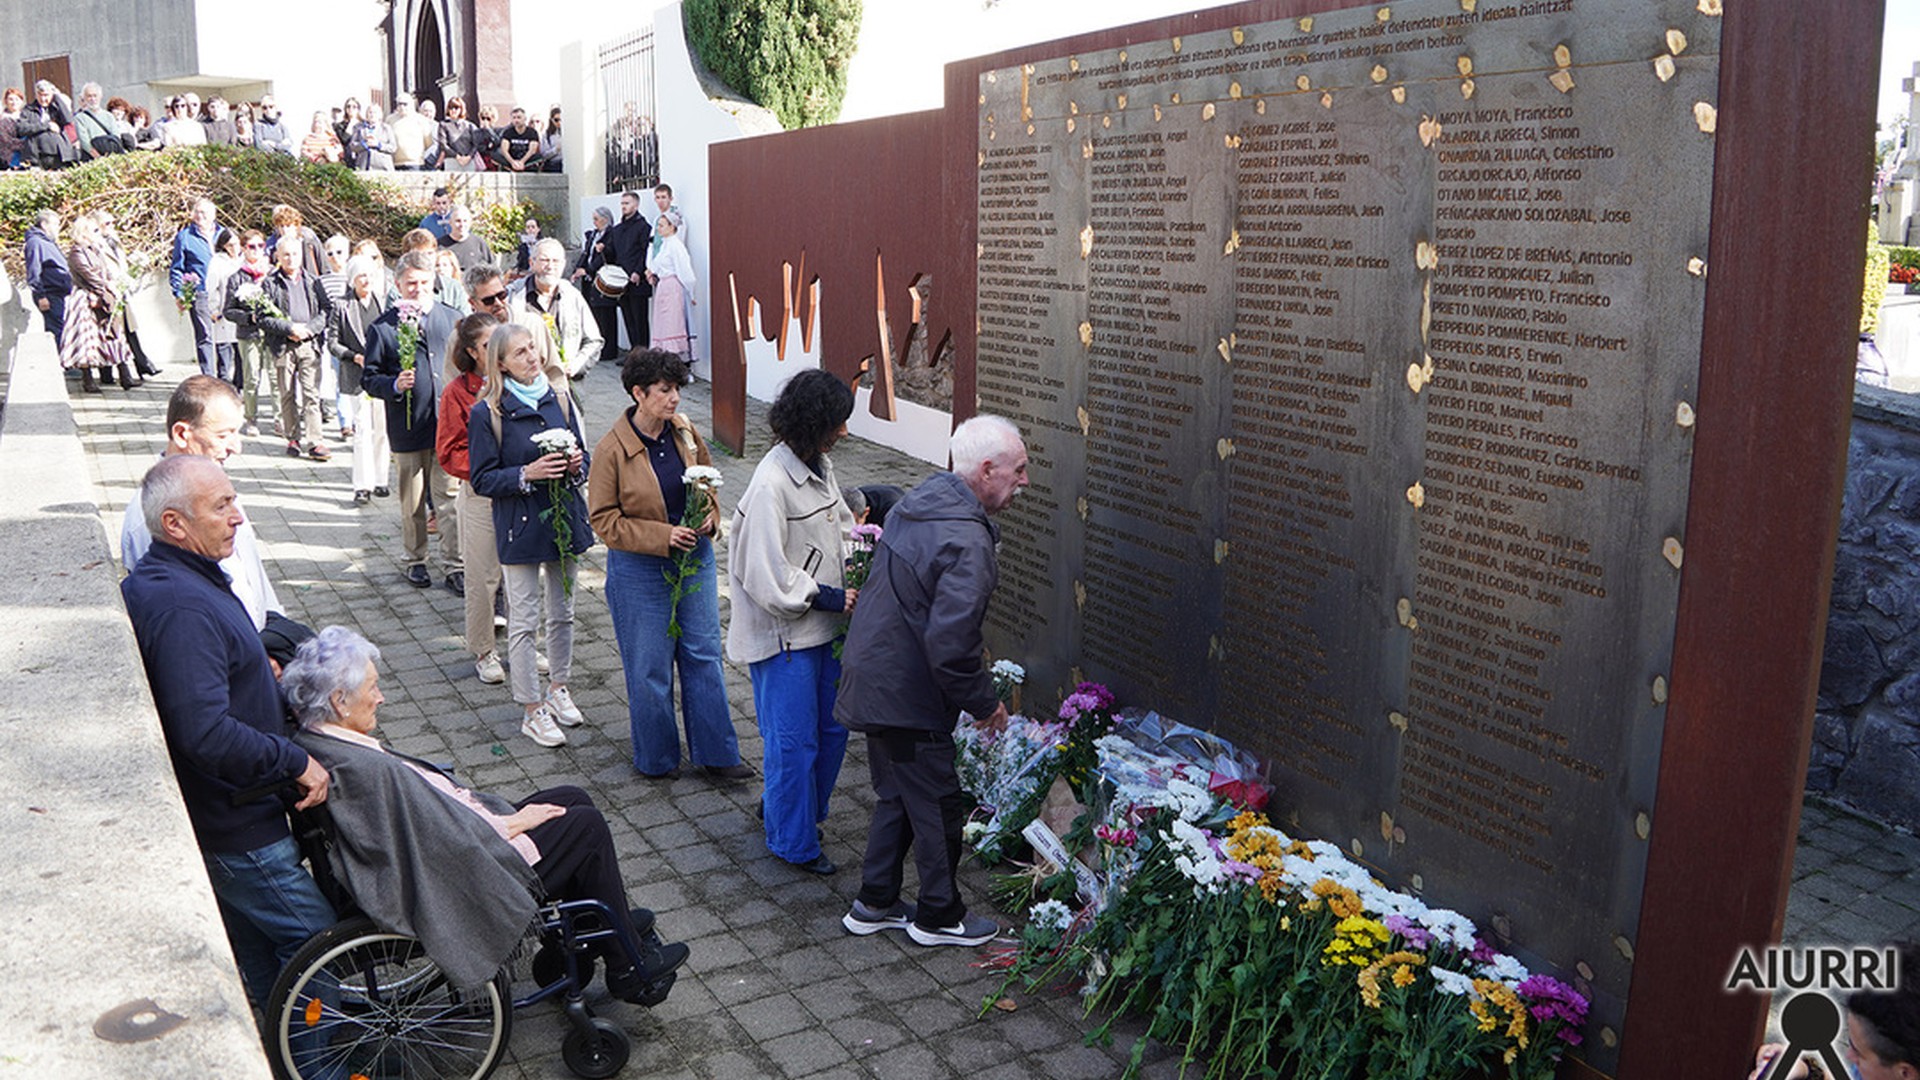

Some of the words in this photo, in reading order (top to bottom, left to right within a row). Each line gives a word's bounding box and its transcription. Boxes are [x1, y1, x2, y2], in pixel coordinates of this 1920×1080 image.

[1446, 14, 1479, 27] zuten
[1440, 112, 1472, 125] MOYA
[1475, 110, 1511, 123] MOYA,
[1514, 105, 1573, 121] Francisco
[1495, 149, 1550, 162] ZULUAGA,
[1553, 146, 1614, 160] Celestino
[1438, 170, 1479, 182] ORCAJO
[1533, 167, 1582, 181] Alfonso
[1507, 248, 1521, 262] DE
[1579, 251, 1632, 266] Antonio
[1550, 290, 1610, 308] Francisco
[1520, 426, 1578, 449] Francisco
